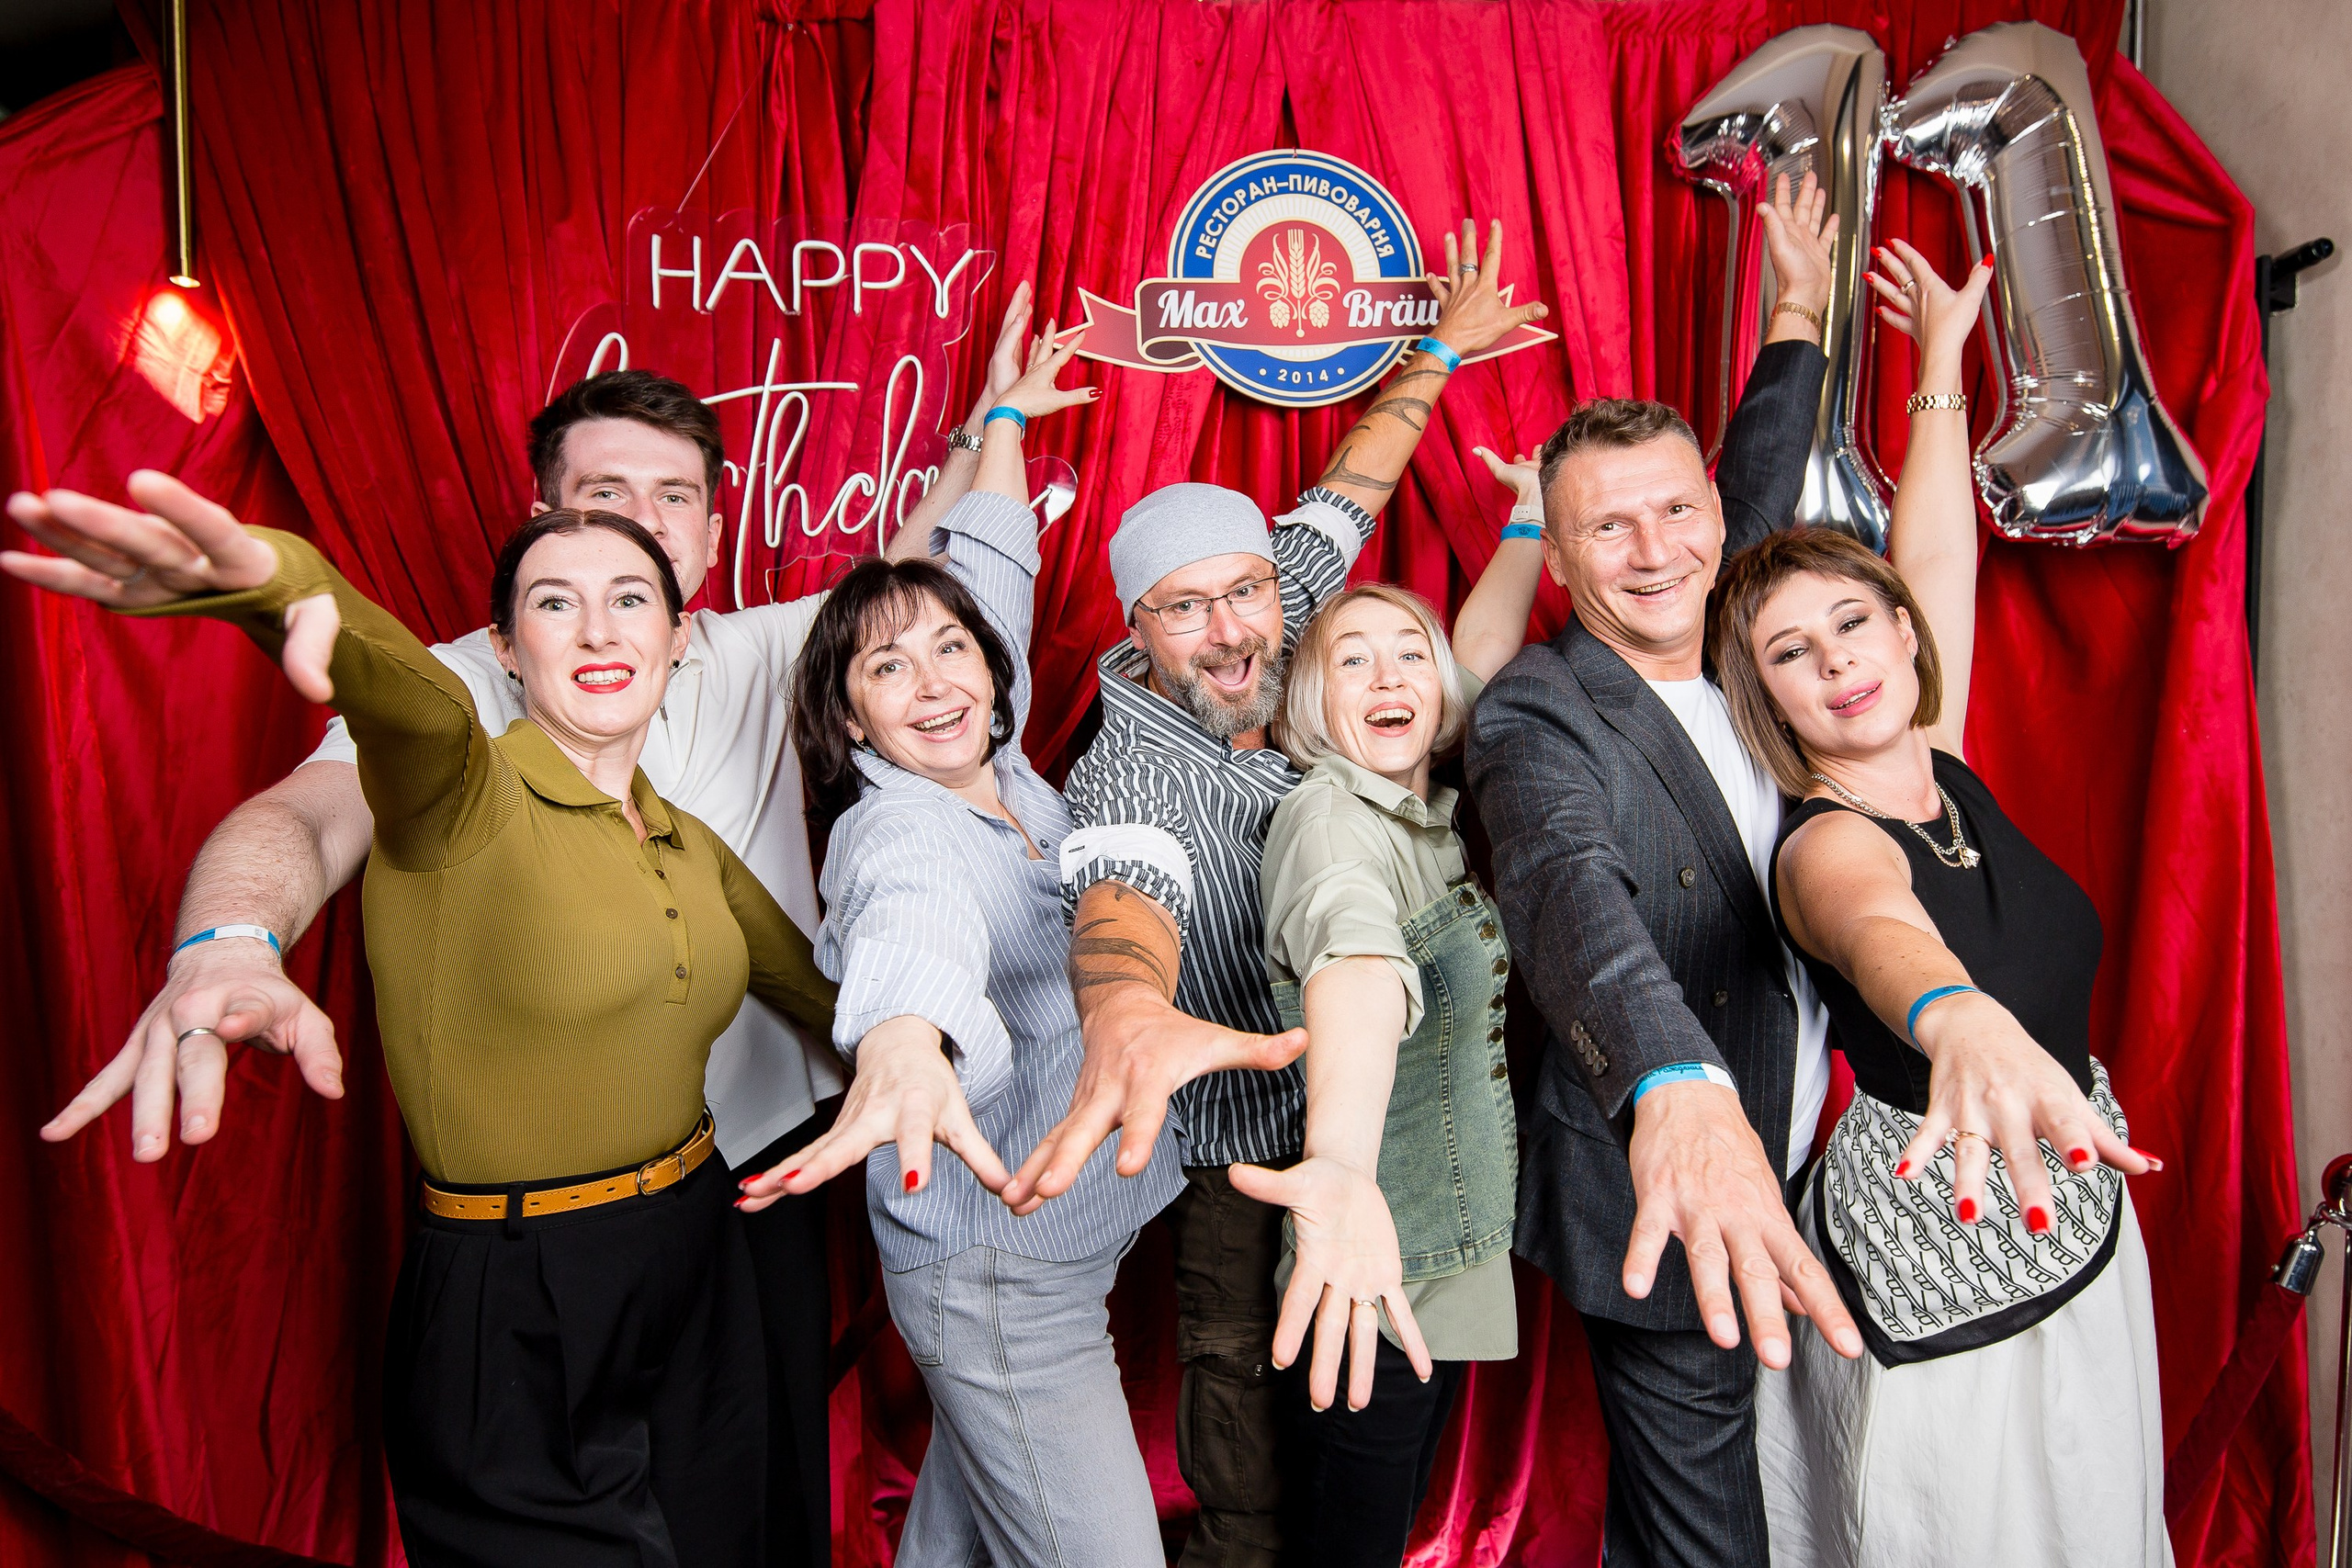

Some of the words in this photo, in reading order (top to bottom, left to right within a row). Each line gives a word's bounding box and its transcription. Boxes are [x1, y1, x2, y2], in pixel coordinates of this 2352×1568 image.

[1195, 175, 1395, 259] РЕСТОРАН-ПИВОВАРНЯ
[650, 234, 974, 318] HAPPY
[1158, 289, 1249, 329] Max
[1342, 288, 1440, 329] Bräu
[1277, 368, 1329, 384] 2014
